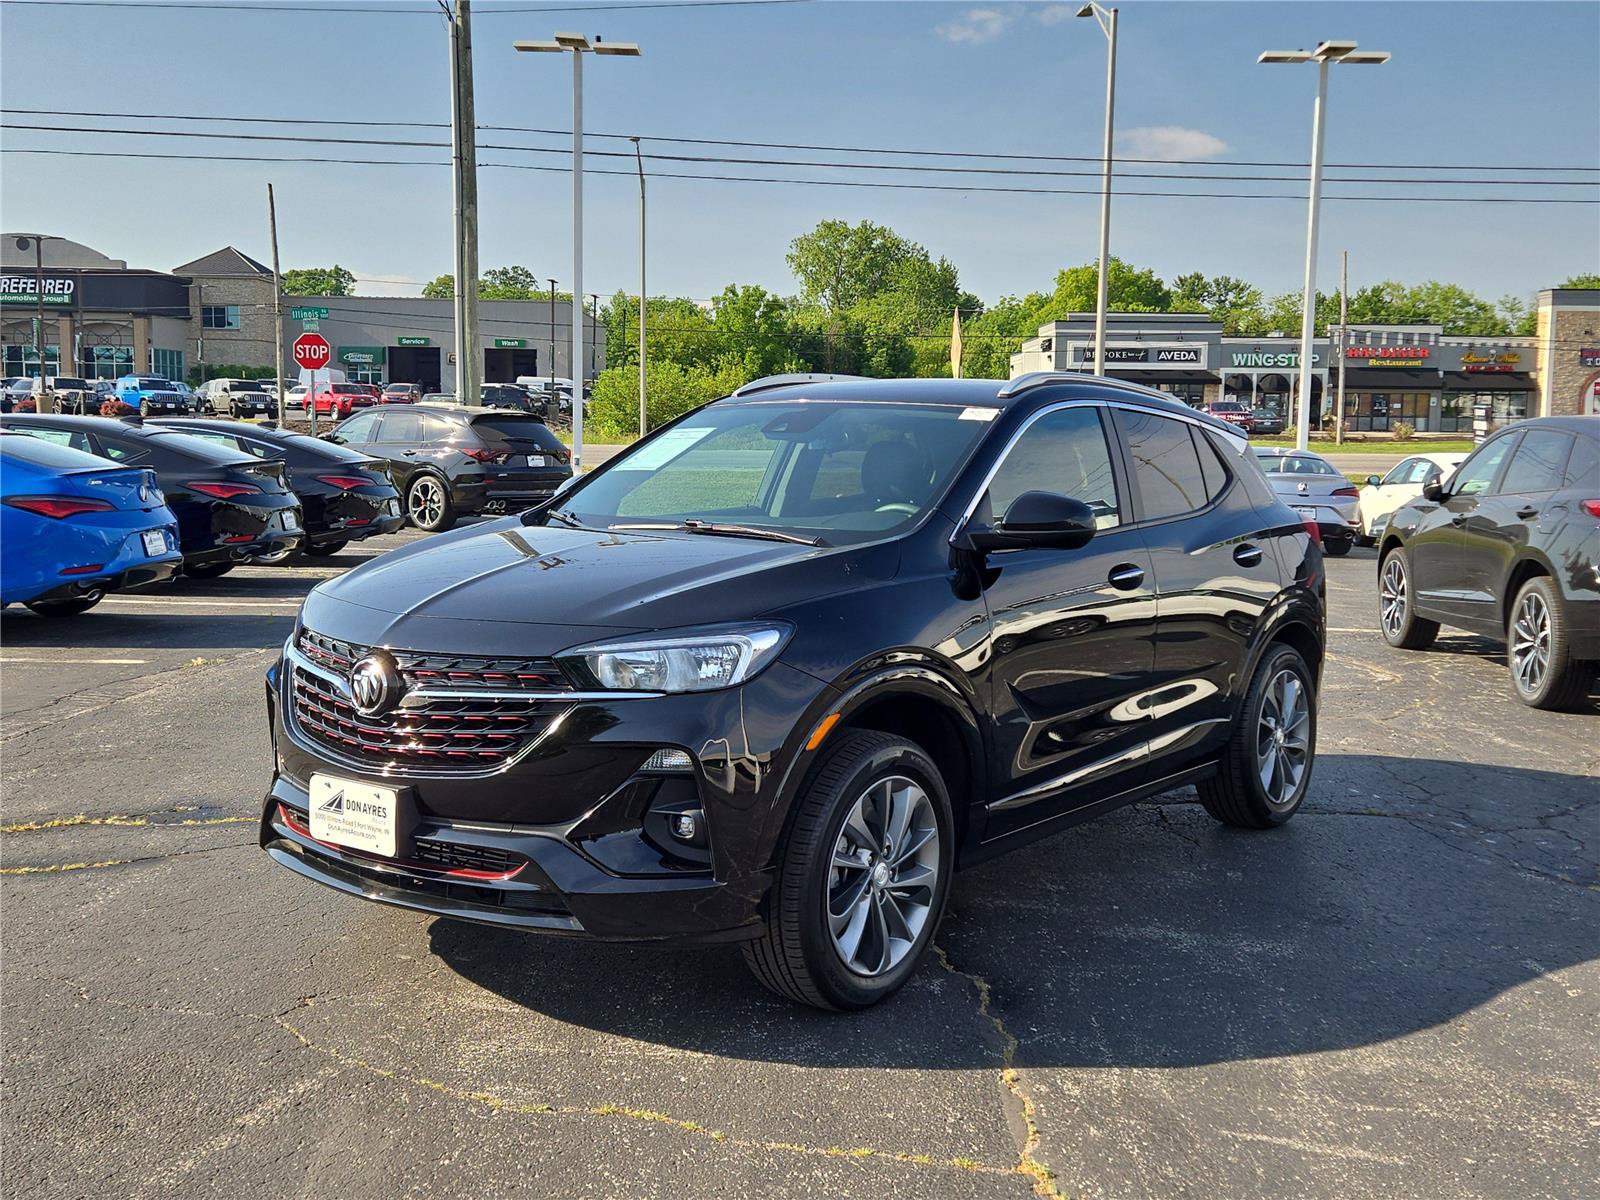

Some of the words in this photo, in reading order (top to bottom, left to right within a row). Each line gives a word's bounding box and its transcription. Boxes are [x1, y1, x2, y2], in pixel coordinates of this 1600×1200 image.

[0, 279, 74, 294] REFERRED
[292, 309, 319, 319] Illinois
[296, 345, 328, 359] STOP
[1158, 351, 1197, 361] AVEDA
